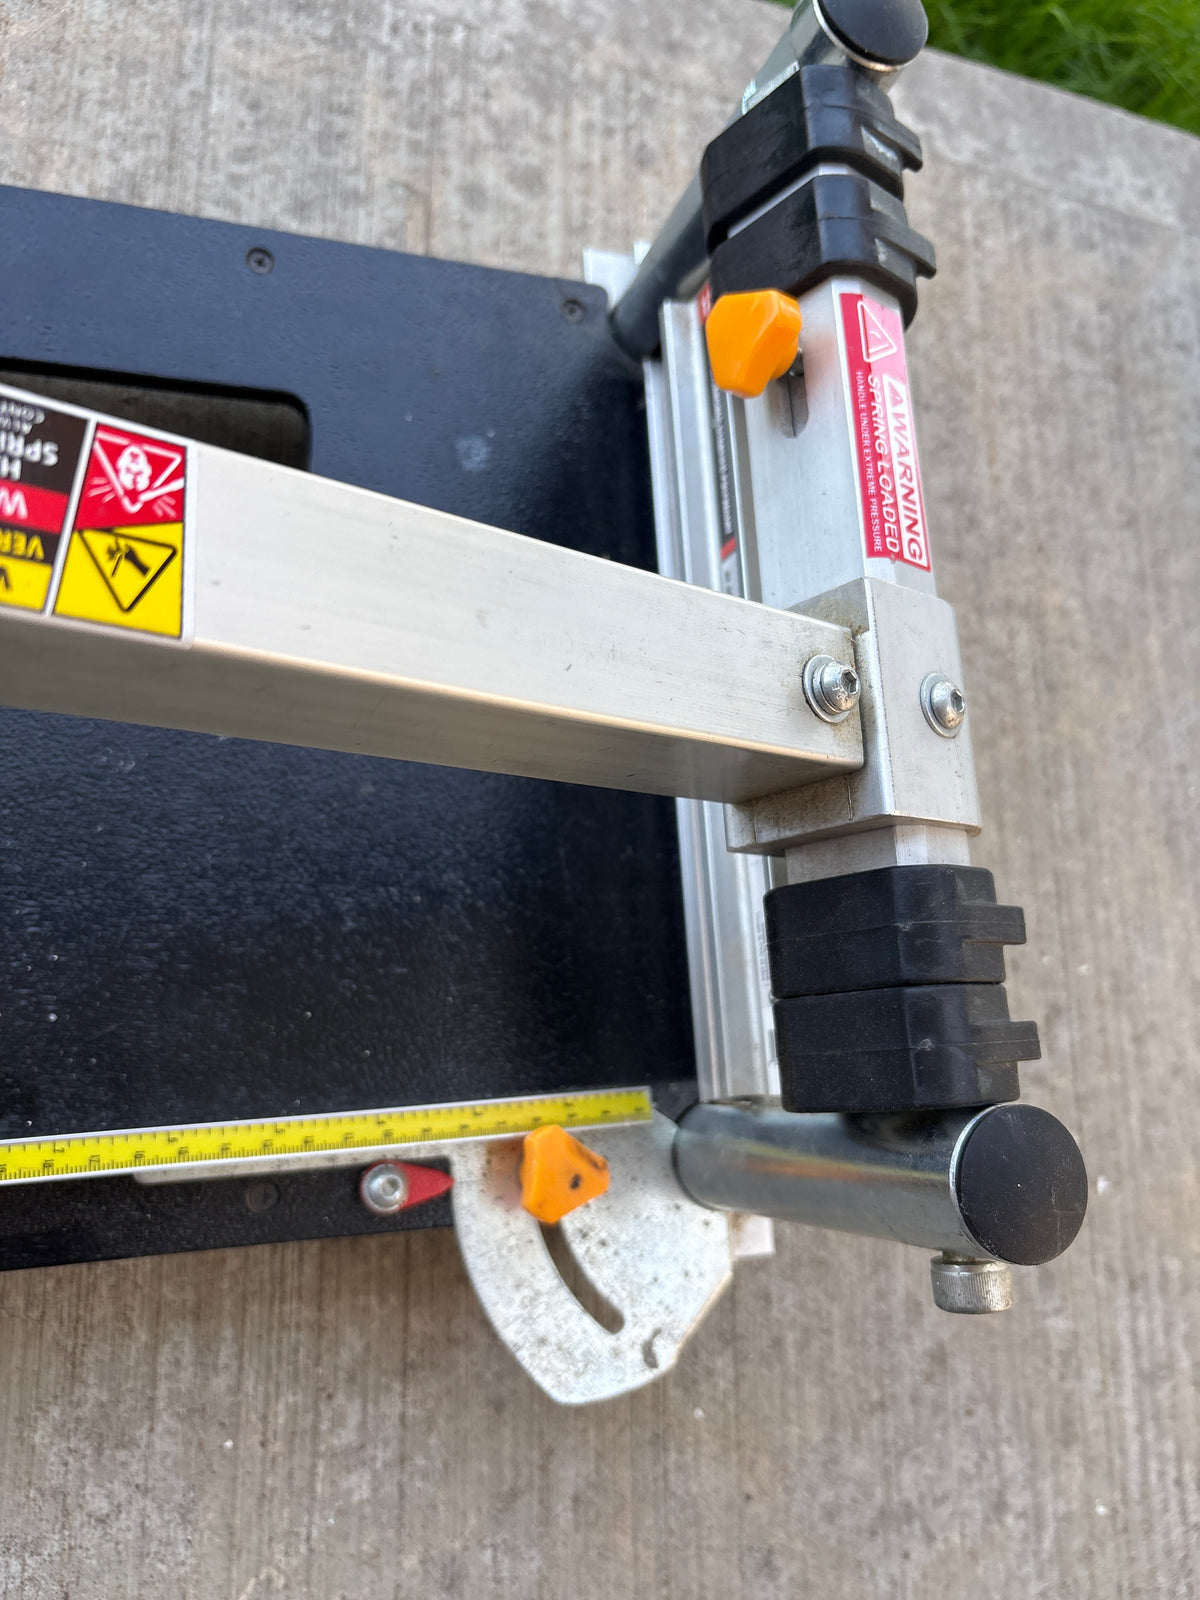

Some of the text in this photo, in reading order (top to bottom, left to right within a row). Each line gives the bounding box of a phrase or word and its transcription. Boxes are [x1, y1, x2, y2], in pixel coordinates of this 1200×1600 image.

[856, 371, 882, 552] HANDLE UNDER EXTREME PRESSURE
[868, 374, 900, 553] SPRING LOADED
[891, 411, 923, 561] WARNING
[43, 1159, 55, 1169] 18
[89, 1154, 100, 1163] 17
